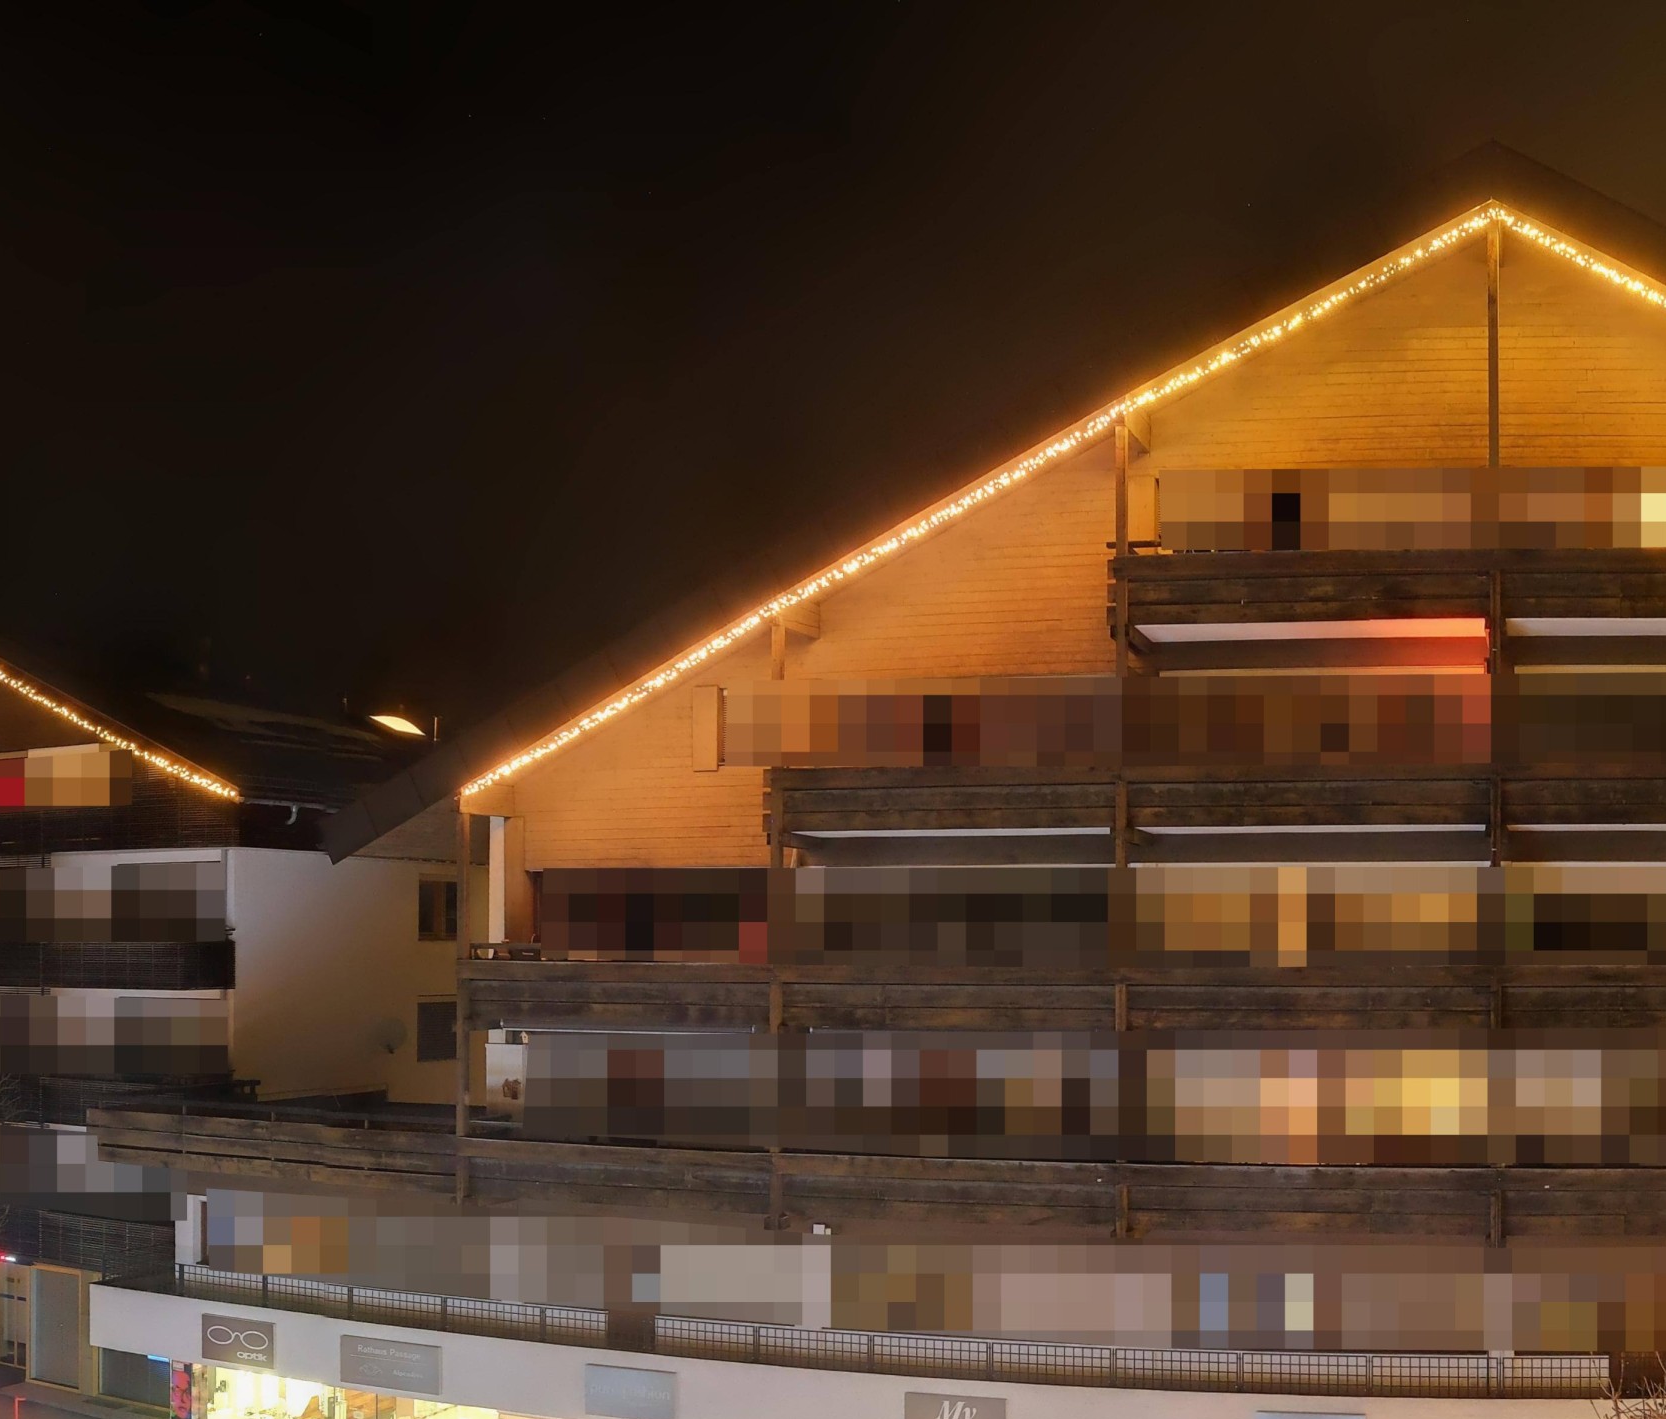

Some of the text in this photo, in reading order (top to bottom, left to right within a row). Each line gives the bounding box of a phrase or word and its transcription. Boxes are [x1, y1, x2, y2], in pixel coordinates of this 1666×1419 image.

[236, 1350, 268, 1362] optik
[357, 1344, 421, 1362] Rathaus Passage
